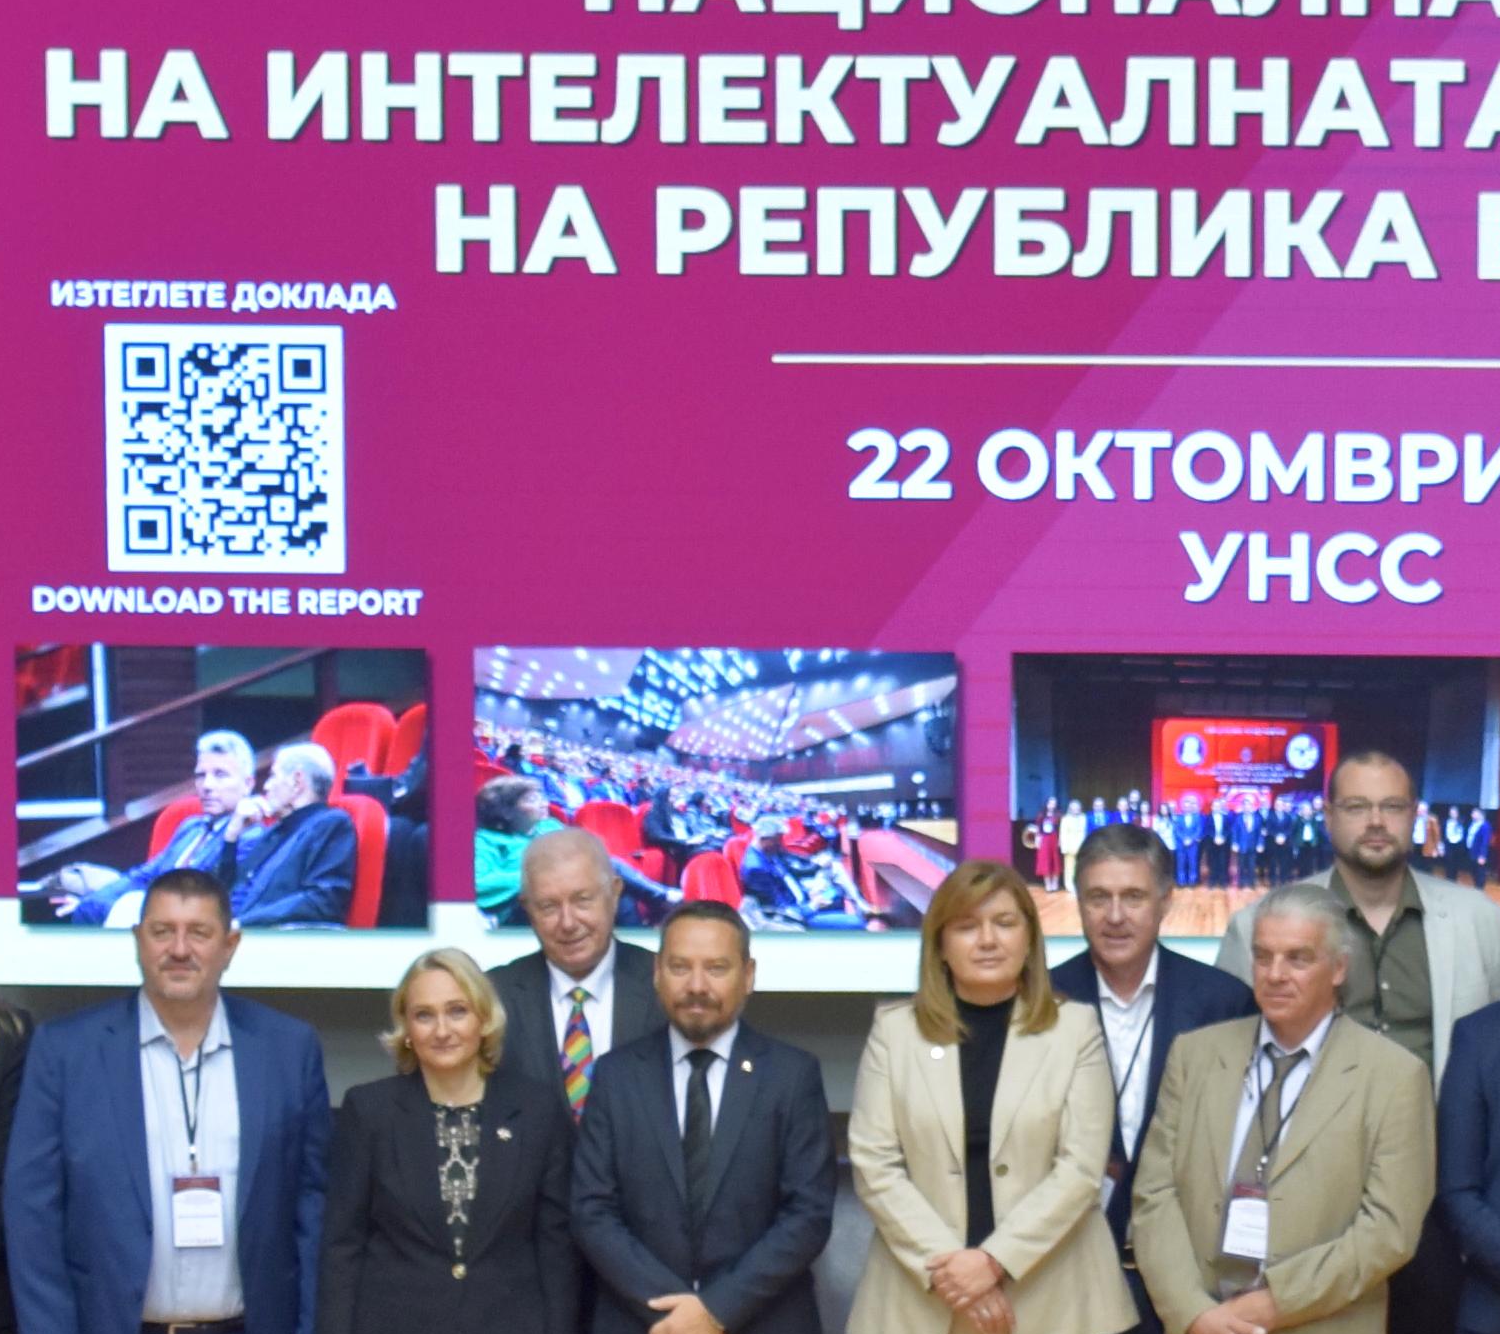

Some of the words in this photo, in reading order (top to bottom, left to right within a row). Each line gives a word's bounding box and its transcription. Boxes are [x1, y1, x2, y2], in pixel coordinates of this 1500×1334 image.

[45, 49, 229, 140] НА
[434, 184, 618, 275] НА
[655, 187, 1438, 280] РЕПУБЛИКА
[50, 280, 227, 310] ИЗТЕГЛЕТЕ
[231, 282, 397, 314] ДОКЛАДА
[846, 427, 953, 500] 22
[31, 586, 224, 615] DOWNLOAD
[228, 588, 293, 616] THE
[298, 588, 423, 617] REPORT
[1179, 531, 1443, 605] УНСС
